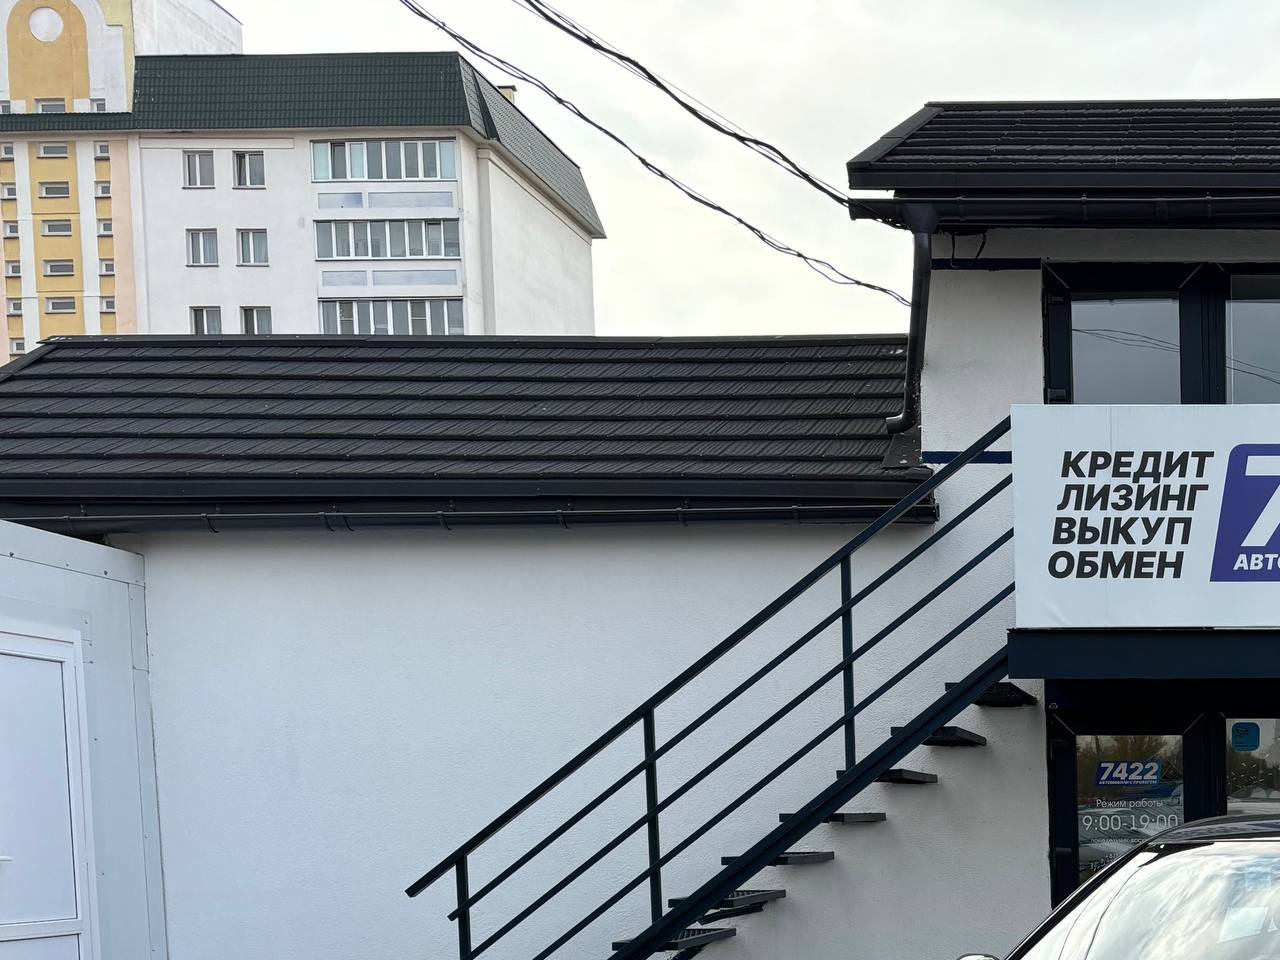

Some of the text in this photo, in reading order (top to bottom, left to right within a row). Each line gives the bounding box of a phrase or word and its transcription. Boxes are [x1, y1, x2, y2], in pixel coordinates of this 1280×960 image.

[1061, 451, 1214, 483] КРЕДИТ
[1057, 484, 1209, 511] ЛИЗИНГ
[1052, 517, 1192, 545] ВЫКУП
[1048, 551, 1184, 578] ОБМЕН
[1100, 762, 1159, 780] 7422
[1096, 798, 1163, 810] Режим работы
